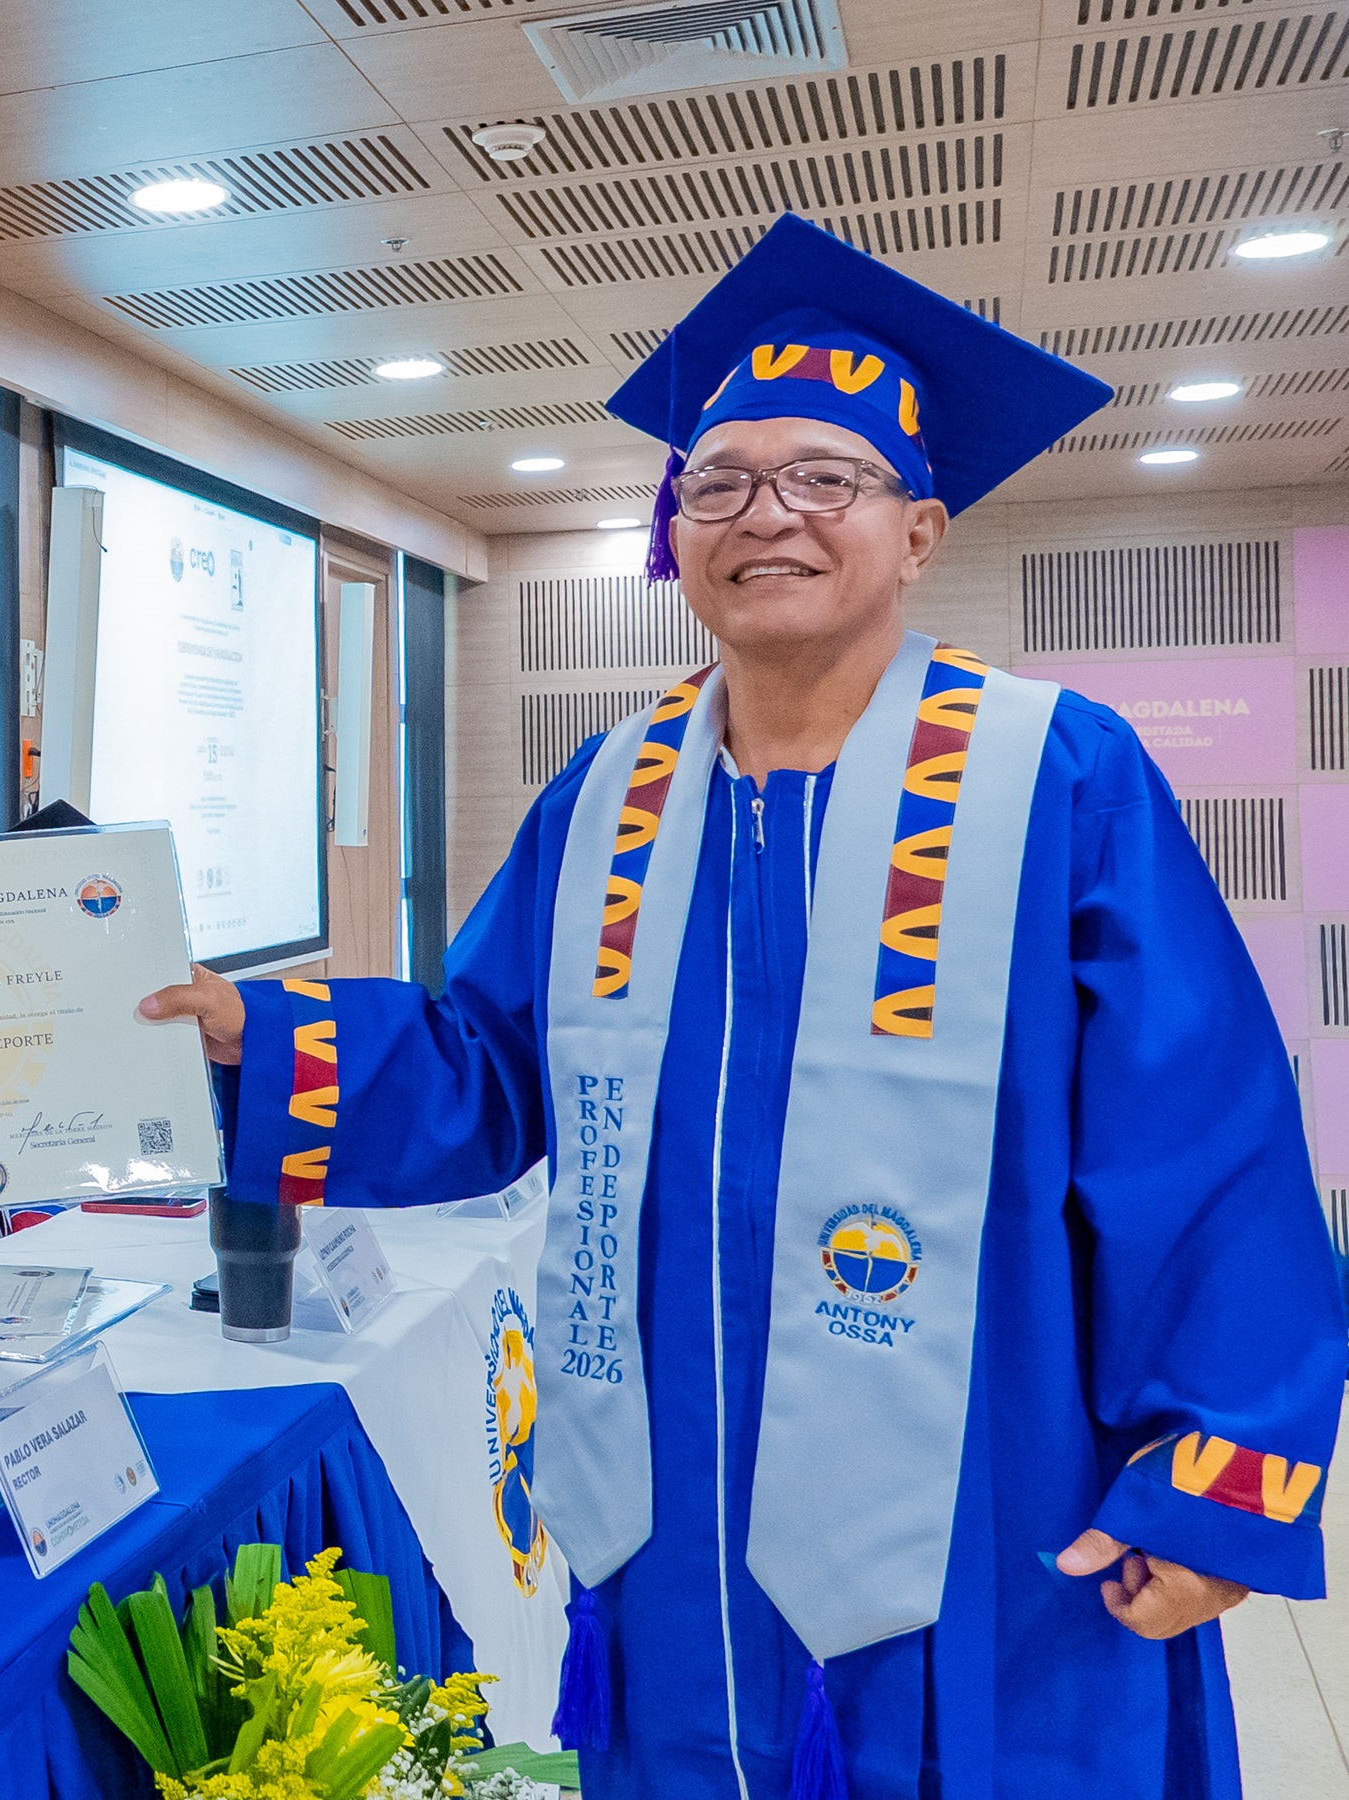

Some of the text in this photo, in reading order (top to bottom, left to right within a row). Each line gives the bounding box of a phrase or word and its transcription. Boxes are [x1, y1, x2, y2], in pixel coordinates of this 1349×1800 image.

[1111, 698, 1251, 719] AGDALENA
[6, 970, 63, 985] FREYLE
[66, 1134, 95, 1145] General
[568, 1074, 599, 1346] PROFESIONAL
[597, 1077, 624, 1352] EN DEPORTE
[817, 1204, 923, 1261] UNIVERSIDAD DEL MAGDALENA
[814, 1300, 916, 1333] ANTONY
[828, 1320, 894, 1348] OSSA
[561, 1349, 624, 1384] 2026
[3, 1410, 88, 1470] PABLO VERA SALAZAR
[12, 1465, 42, 1491] RECTOR
